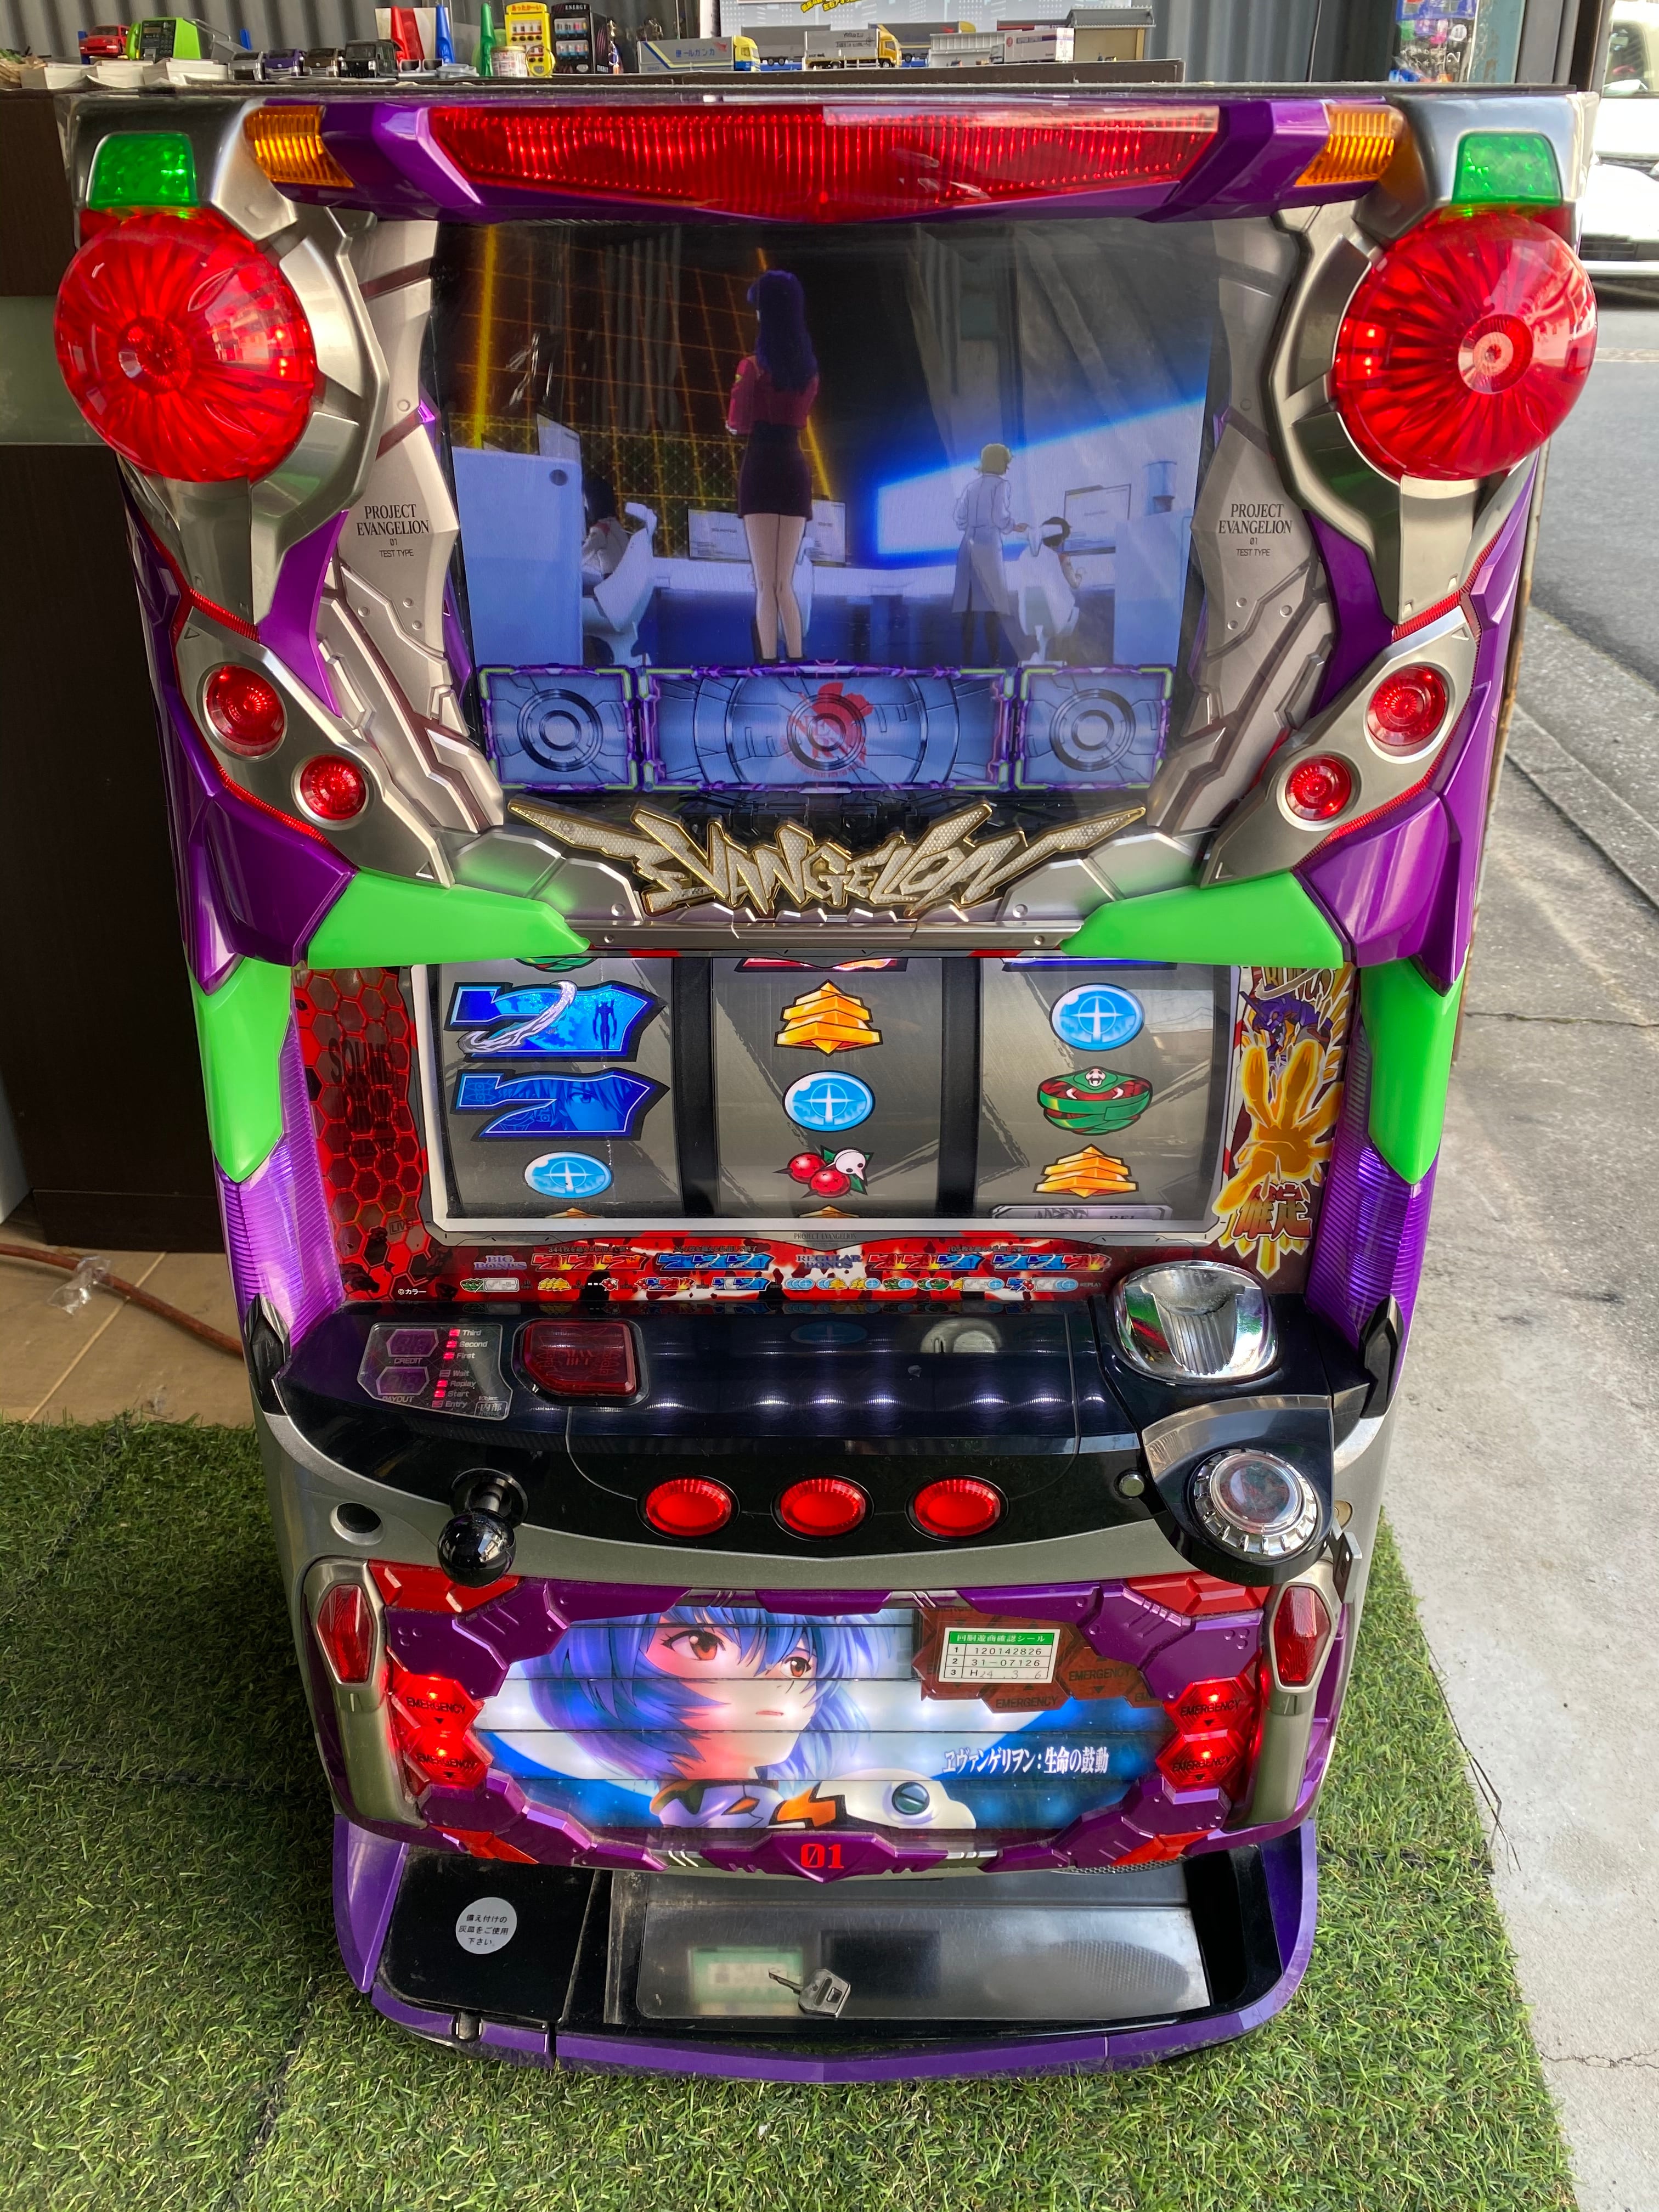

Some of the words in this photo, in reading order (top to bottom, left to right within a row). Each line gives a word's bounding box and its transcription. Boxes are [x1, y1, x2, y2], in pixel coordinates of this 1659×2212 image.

[364, 504, 416, 519] PROJECT
[1231, 504, 1284, 517] PROJECT
[357, 520, 430, 536] EVANGELION
[1218, 520, 1293, 534] EVANGELION
[379, 549, 395, 558] TEST
[396, 549, 414, 557] TYPE
[508, 799, 1146, 916] EVANGELION
[1232, 1183, 1312, 1242] 確定
[474, 1262, 527, 1271] BONUS
[393, 1357, 423, 1365] CREDIT
[450, 1380, 476, 1389] Replay
[445, 1401, 468, 1409] Entry
[956, 1634, 1045, 1643] 回胴遊商確認シール
[1069, 1667, 1132, 1682] EMERGENCY
[406, 1697, 466, 1714] EMERGENCY
[996, 1696, 1059, 1708] EMERGENCY
[1180, 1699, 1242, 1716] EMERGENCY
[416, 1753, 478, 1770] EMERGENCY
[1171, 1755, 1232, 1772] EMERGENCY
[801, 1843, 844, 1869] 01
[466, 1914, 507, 1923] 備え付けの
[458, 1925, 509, 1936] 灰皿をご使用
